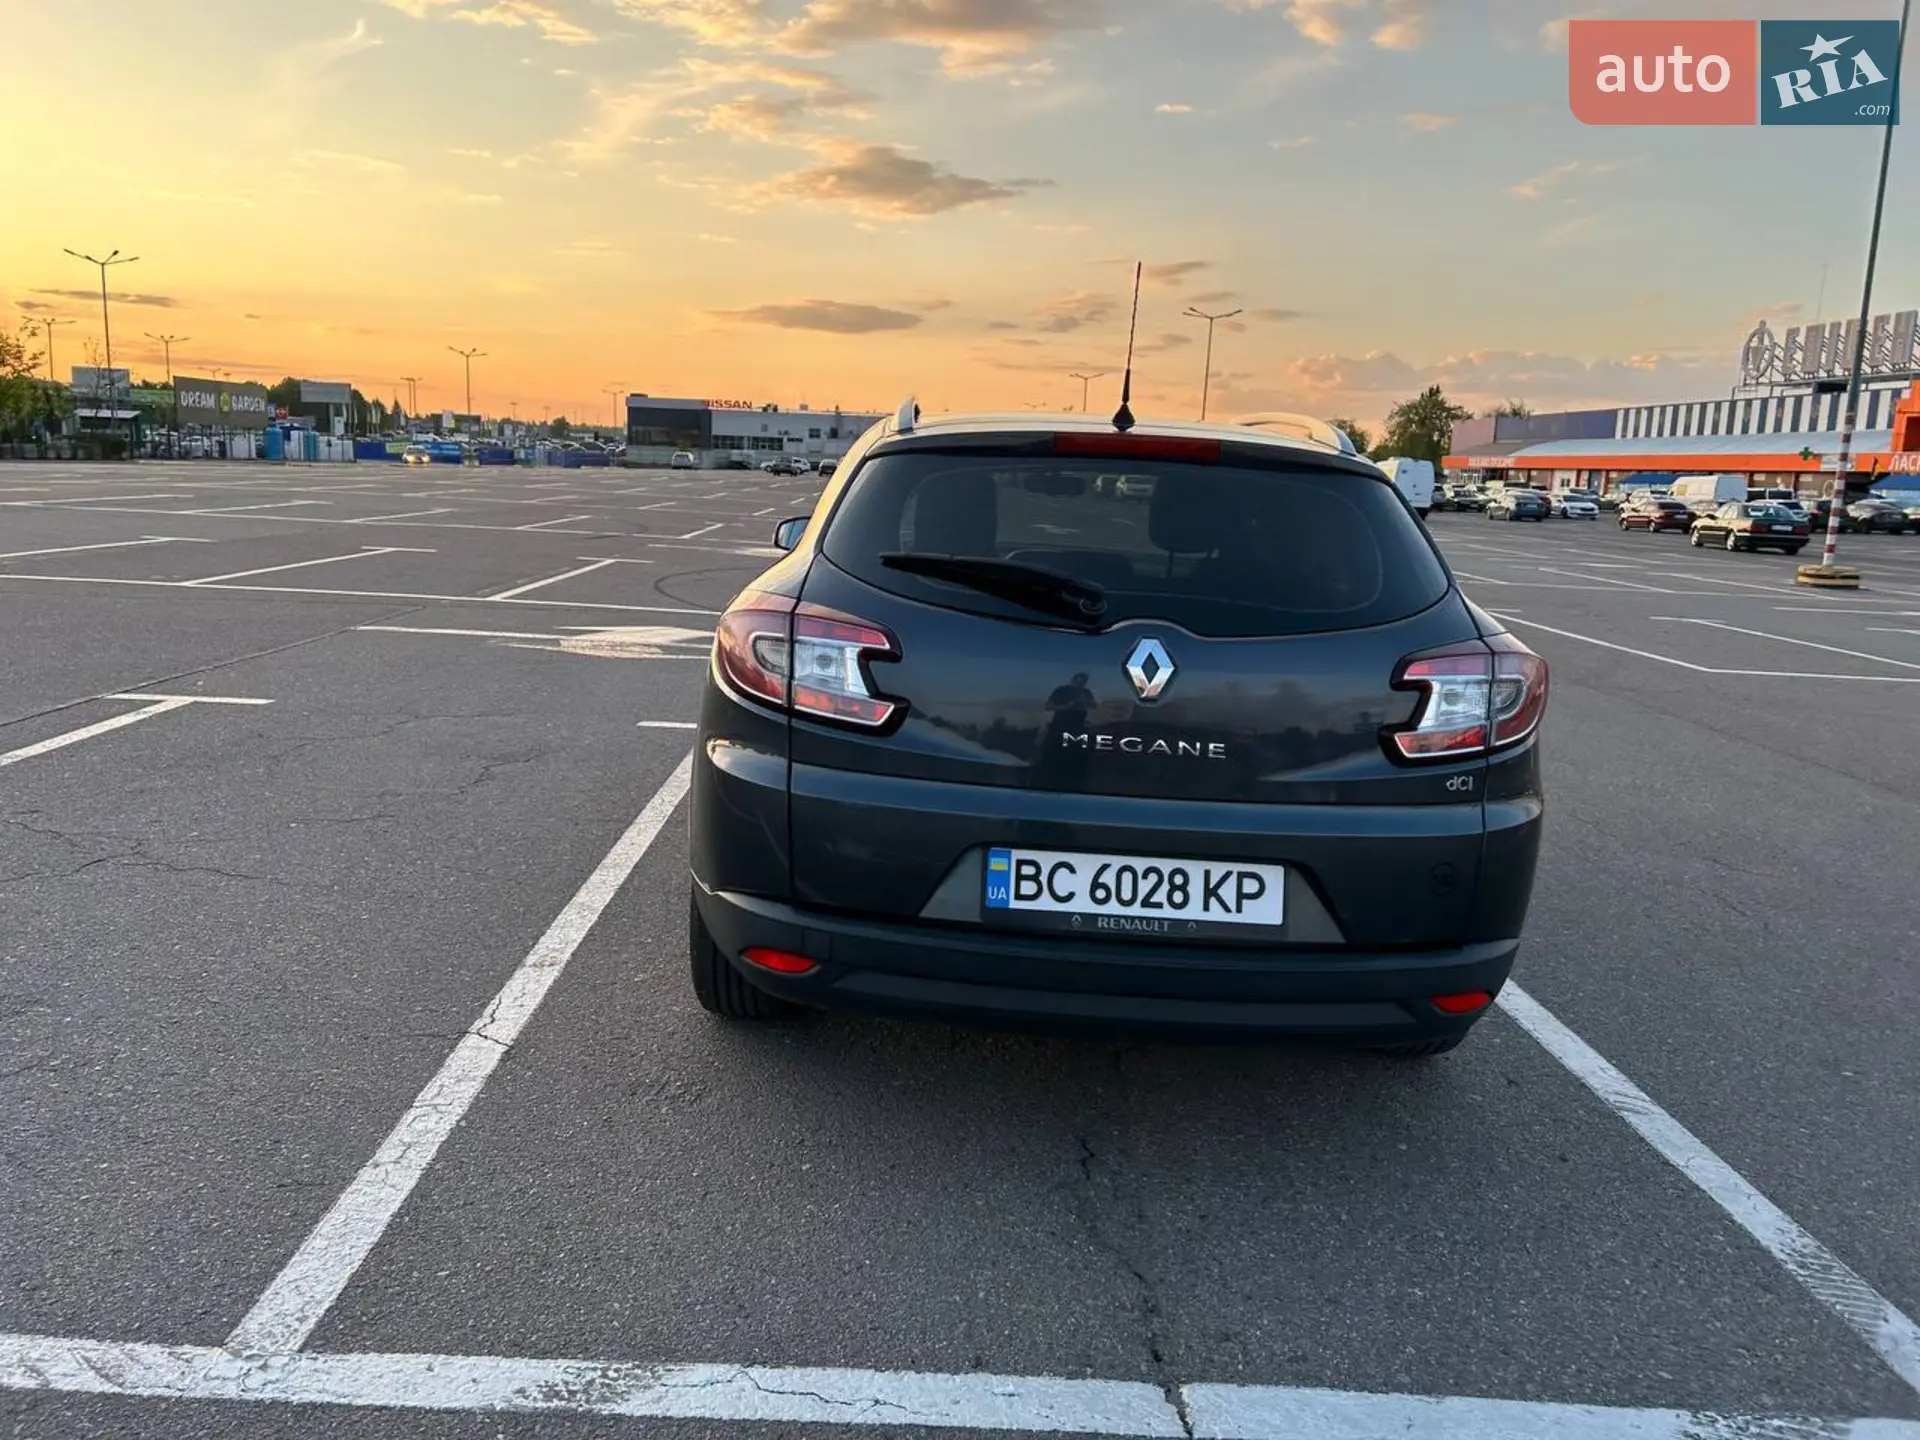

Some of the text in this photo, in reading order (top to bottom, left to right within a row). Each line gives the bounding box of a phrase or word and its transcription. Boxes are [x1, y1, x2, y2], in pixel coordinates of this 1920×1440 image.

[181, 391, 265, 412] DREAM GARDEN
[1062, 732, 1226, 759] MEGANE
[987, 886, 1008, 901] UA
[1013, 858, 1267, 914] BC 6028 KP
[1097, 915, 1171, 933] RENAULT
